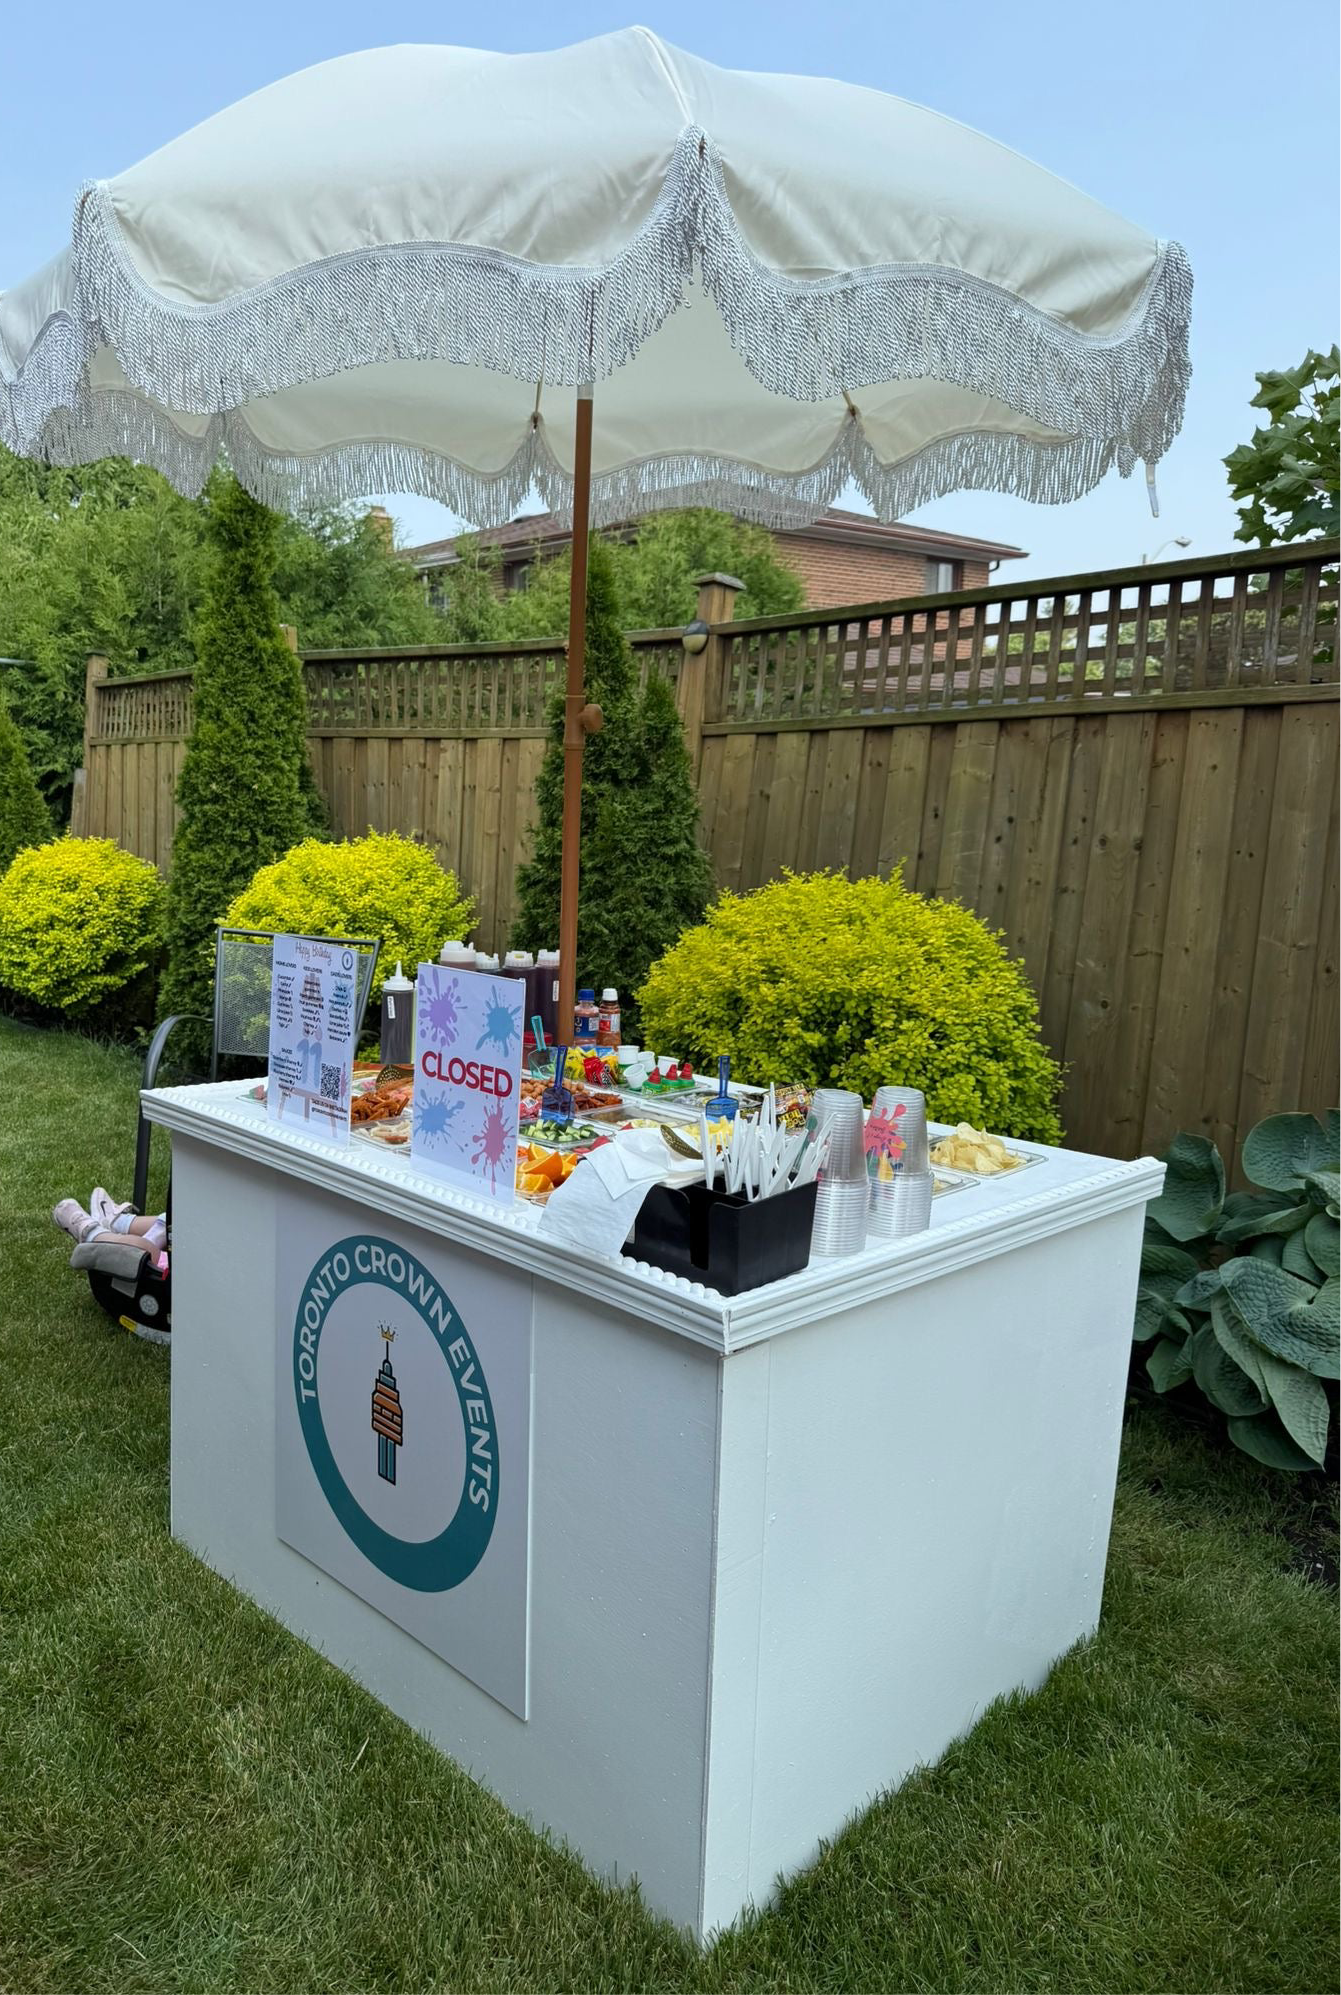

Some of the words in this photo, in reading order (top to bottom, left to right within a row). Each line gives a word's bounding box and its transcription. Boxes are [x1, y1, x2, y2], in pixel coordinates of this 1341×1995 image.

[295, 941, 311, 962] Happy
[312, 944, 332, 966] Birthday
[421, 1050, 513, 1098] CLOSED
[298, 1252, 351, 1404] TORONTO
[354, 1244, 453, 1335] CROWN
[448, 1336, 493, 1513] EVENTS
